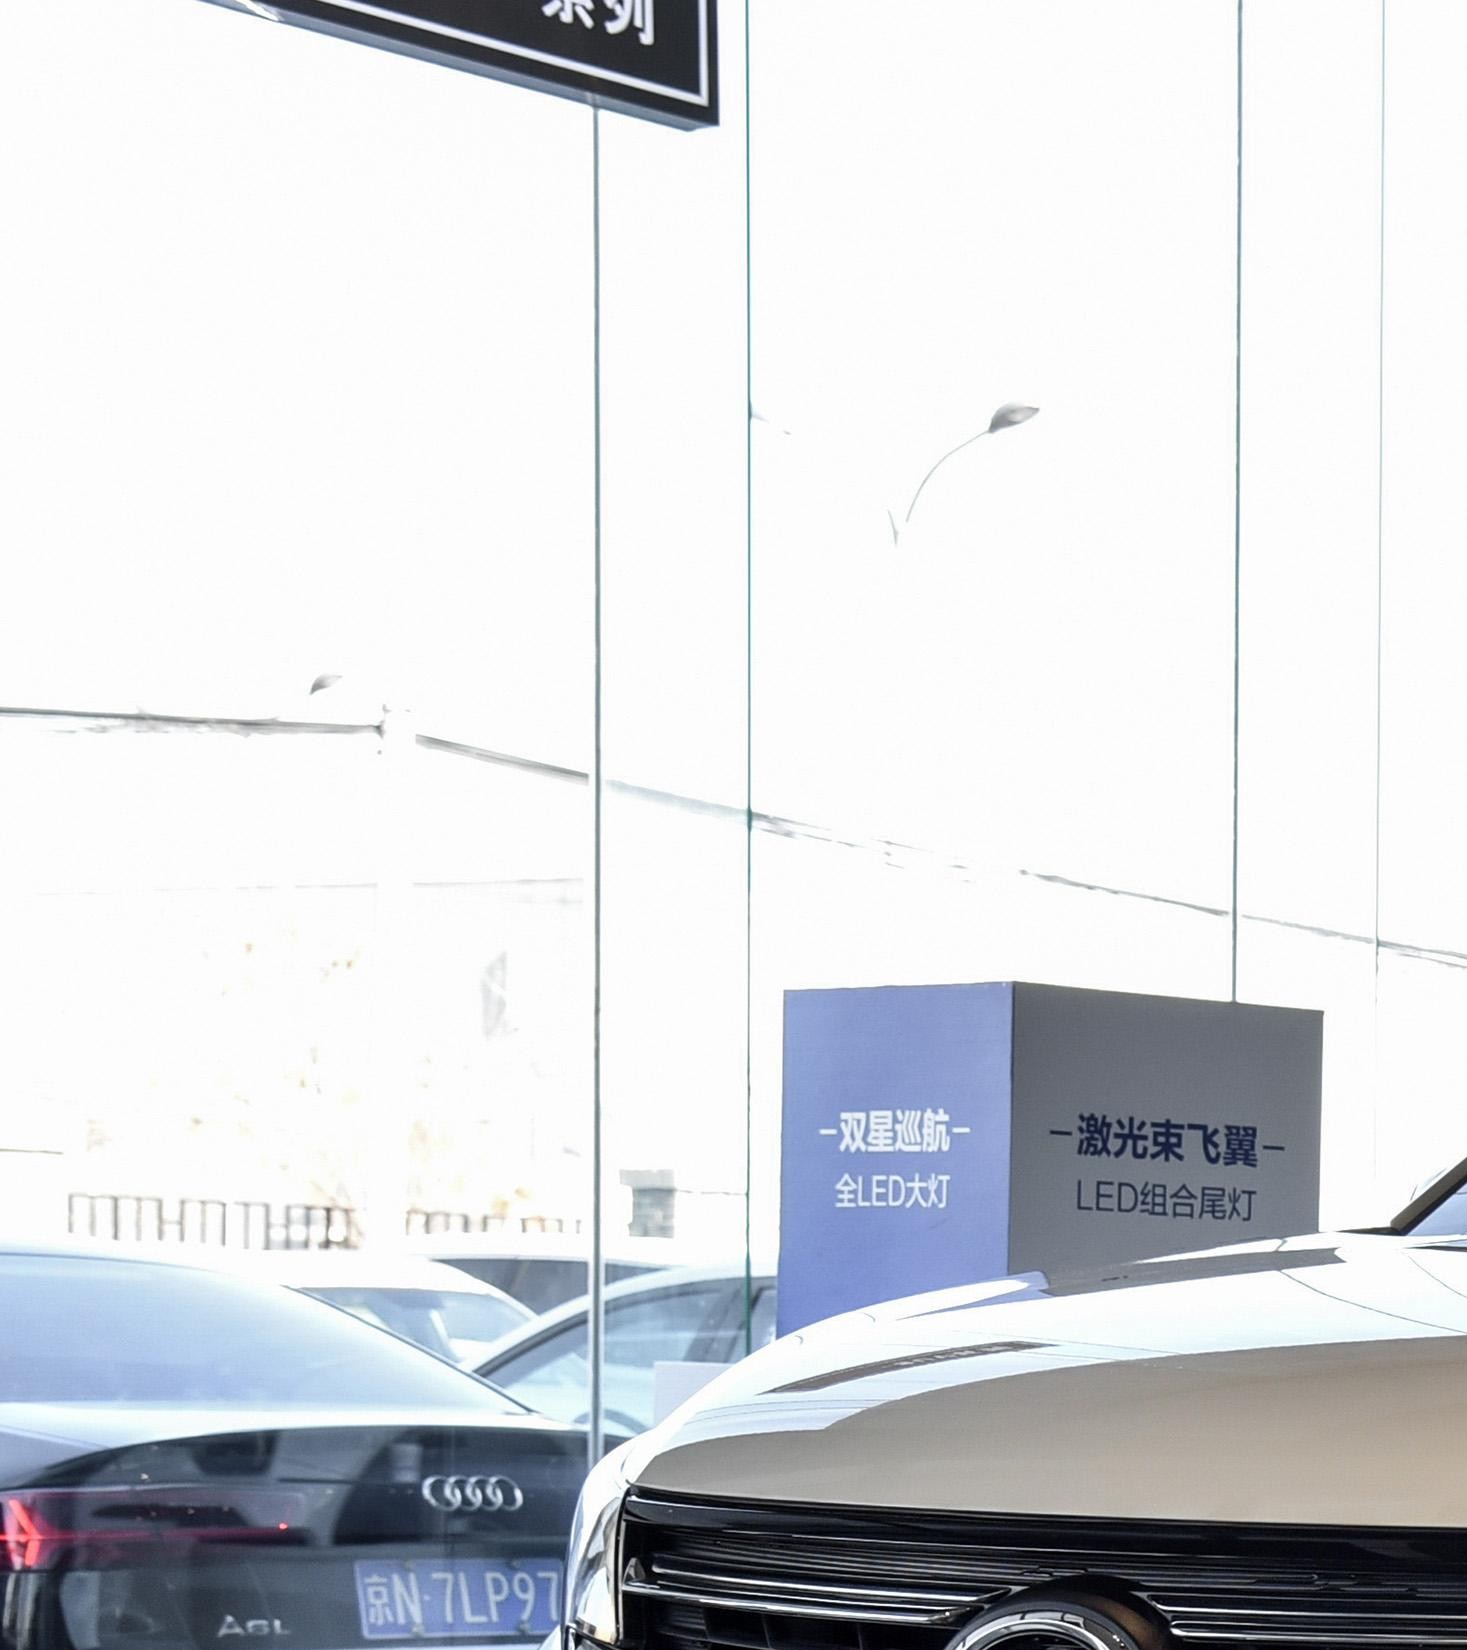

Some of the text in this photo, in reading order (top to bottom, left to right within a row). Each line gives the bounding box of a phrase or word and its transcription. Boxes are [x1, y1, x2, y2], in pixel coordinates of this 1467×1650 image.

[835, 1173, 950, 1209] 全LED大灯
[1075, 1178, 1257, 1222] LED组合尾灯
[217, 1613, 292, 1639] A6L
